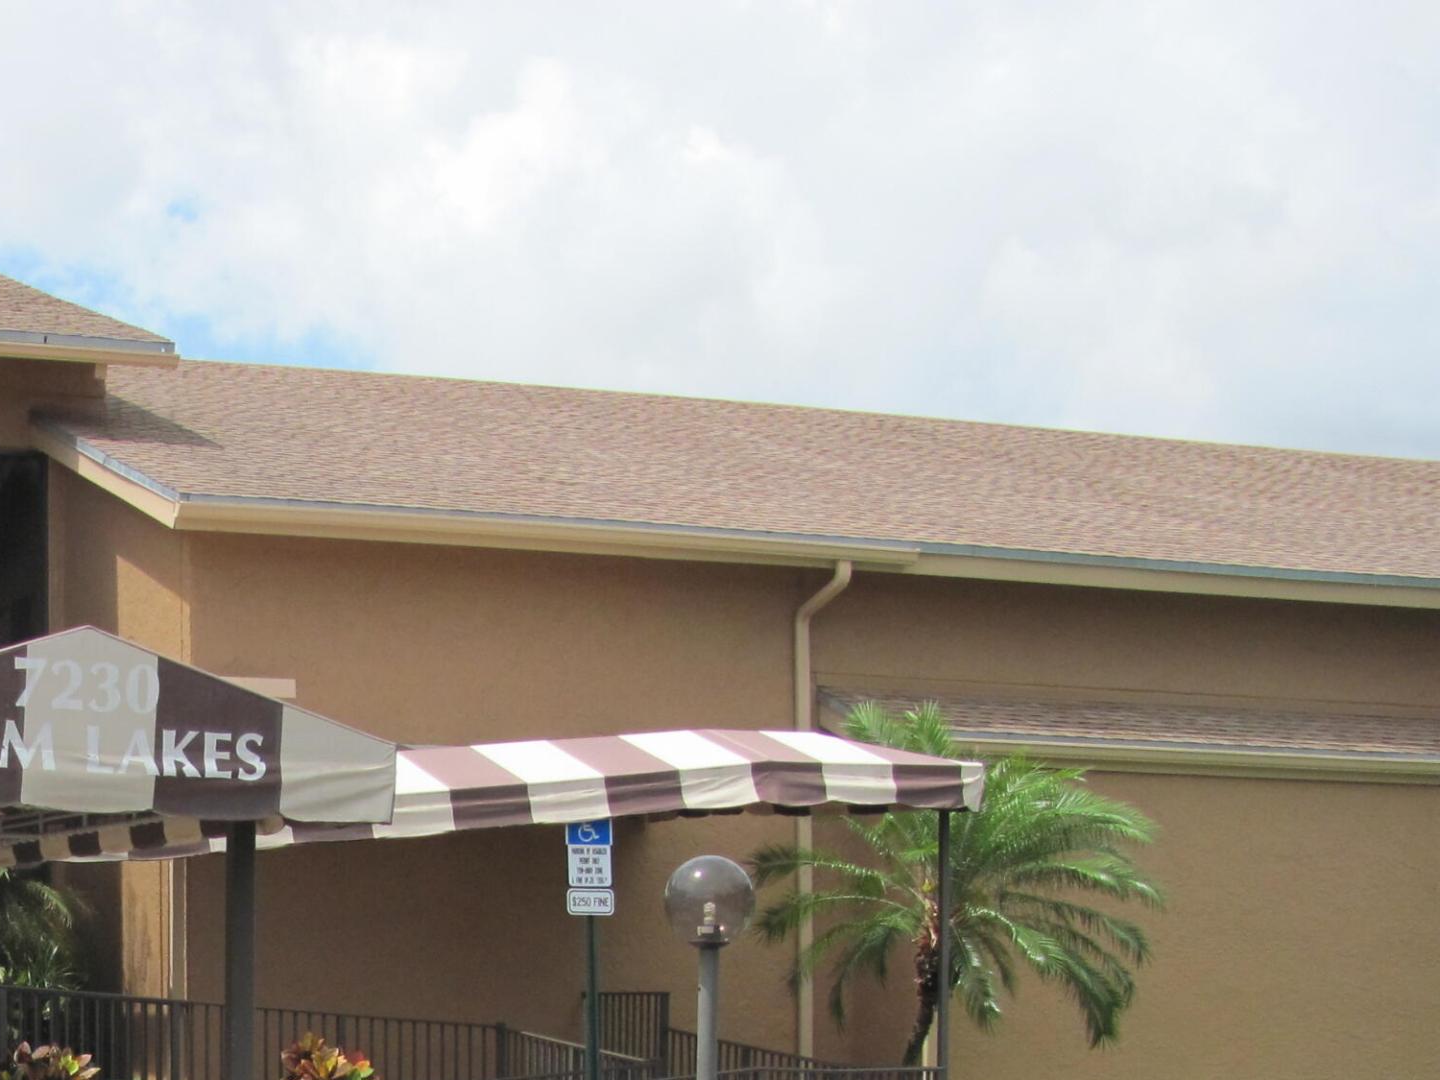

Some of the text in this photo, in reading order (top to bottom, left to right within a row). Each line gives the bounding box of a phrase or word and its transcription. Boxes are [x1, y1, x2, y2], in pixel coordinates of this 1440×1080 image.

[14, 657, 160, 713] 7230
[86, 725, 267, 783] LAKES
[572, 896, 609, 907] $250 FINE
